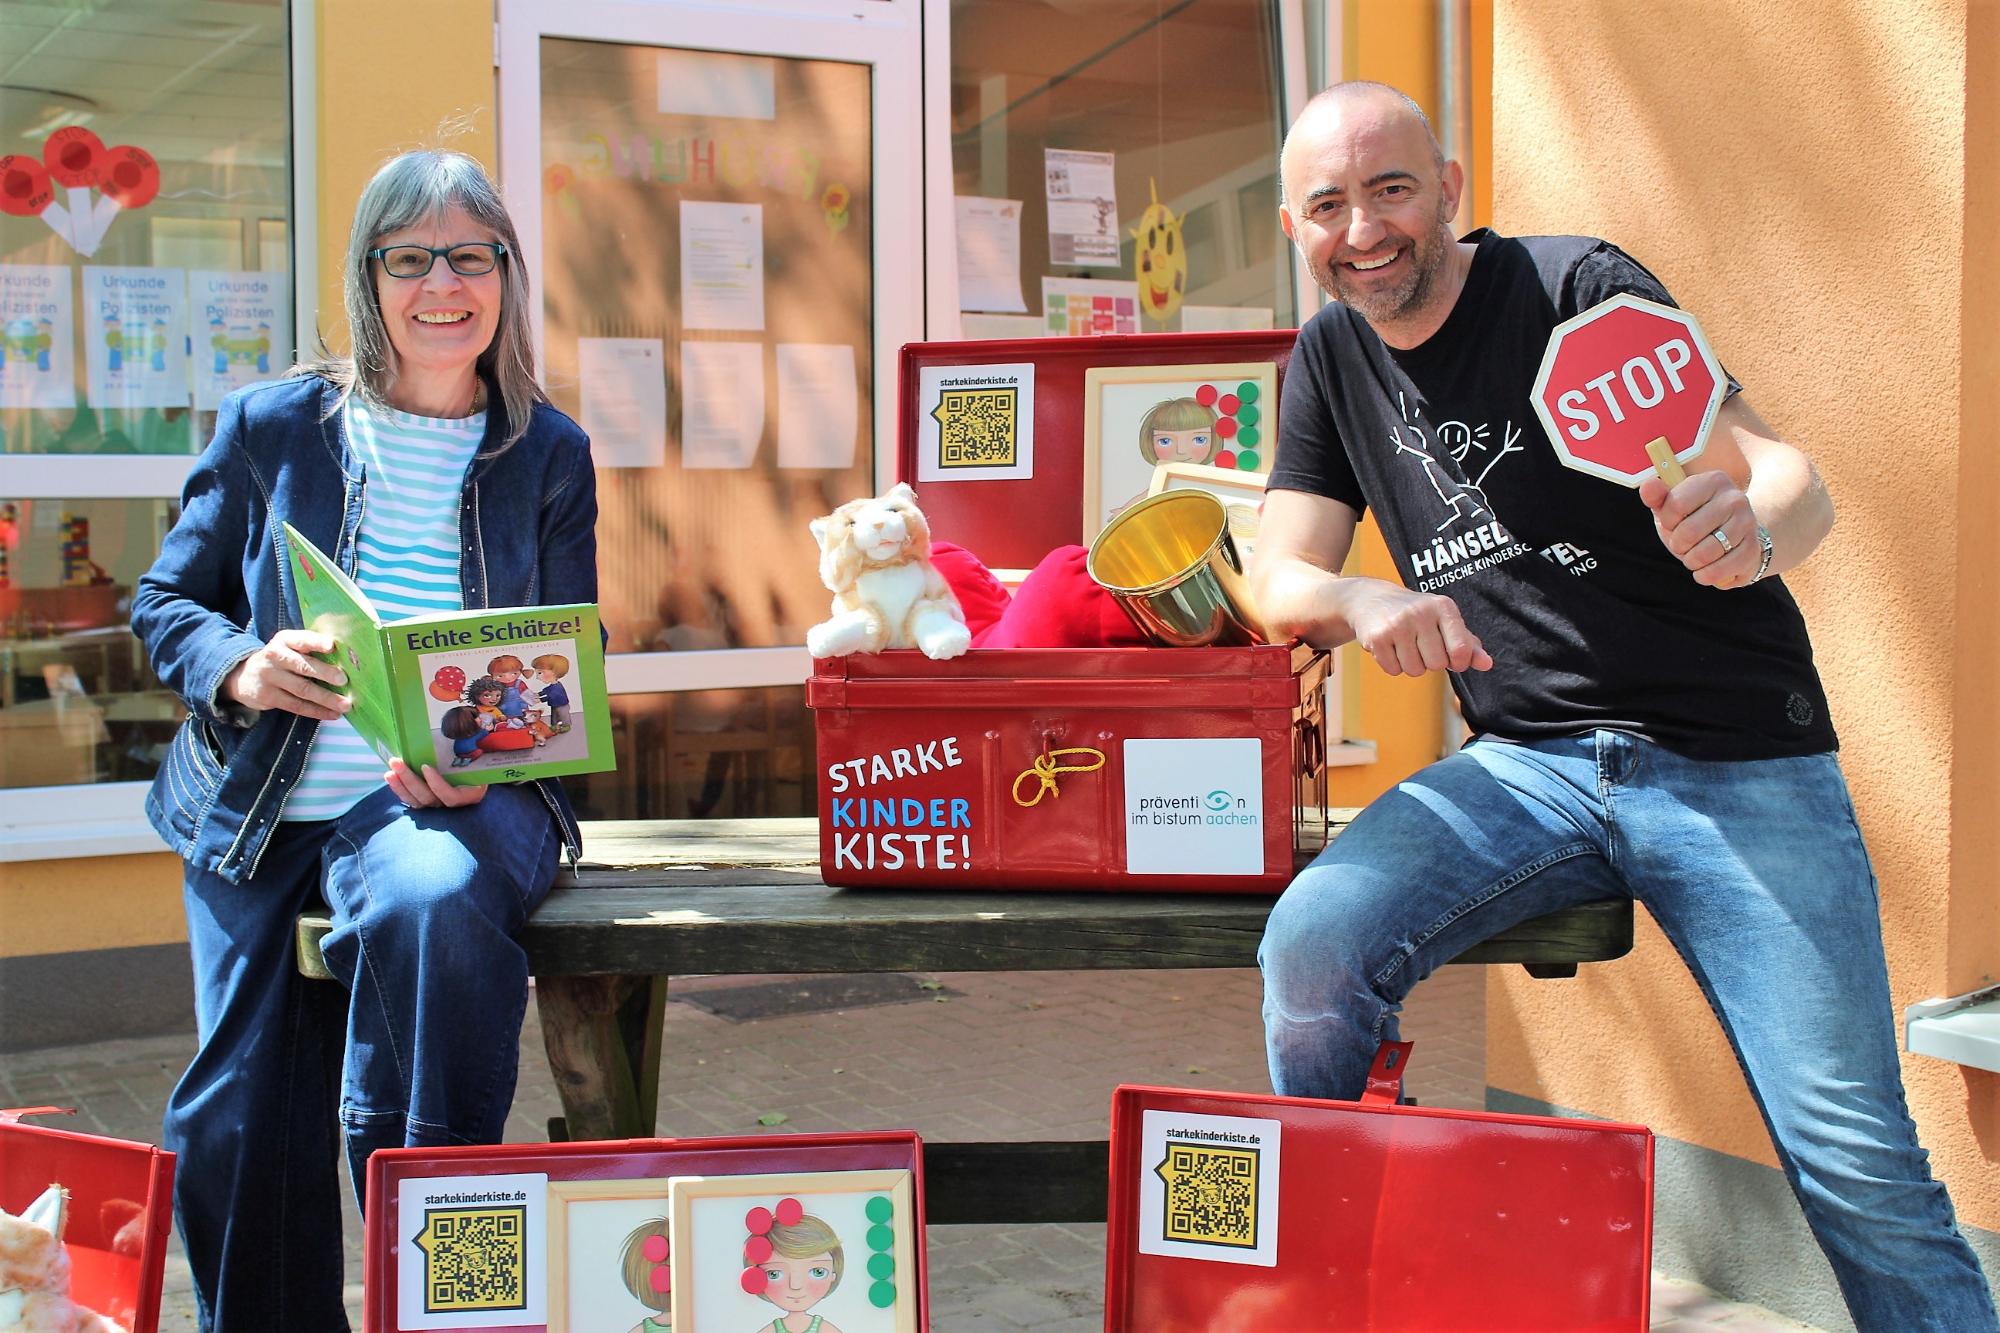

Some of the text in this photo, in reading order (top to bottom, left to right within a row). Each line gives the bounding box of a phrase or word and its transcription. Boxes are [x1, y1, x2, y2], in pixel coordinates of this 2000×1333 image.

[103, 275, 166, 288] Urkunde
[208, 280, 269, 293] Urkunde
[206, 305, 274, 318] Polizisten
[940, 376, 1018, 387] starkekinderkiste.de
[1556, 338, 1692, 441] STOP
[1411, 520, 1509, 577] HÄNSEL
[1419, 564, 1475, 593] DEUTSCHE
[407, 616, 582, 651] Echte Schätze!
[828, 736, 963, 793] STARKE
[832, 797, 972, 828] KINDER
[1131, 811, 1258, 825] im bistum aachen
[834, 832, 972, 870] KISTE!
[1166, 1128, 1261, 1145] starkekinderkiste.de
[424, 1190, 527, 1205] starkekinderkiste.de
